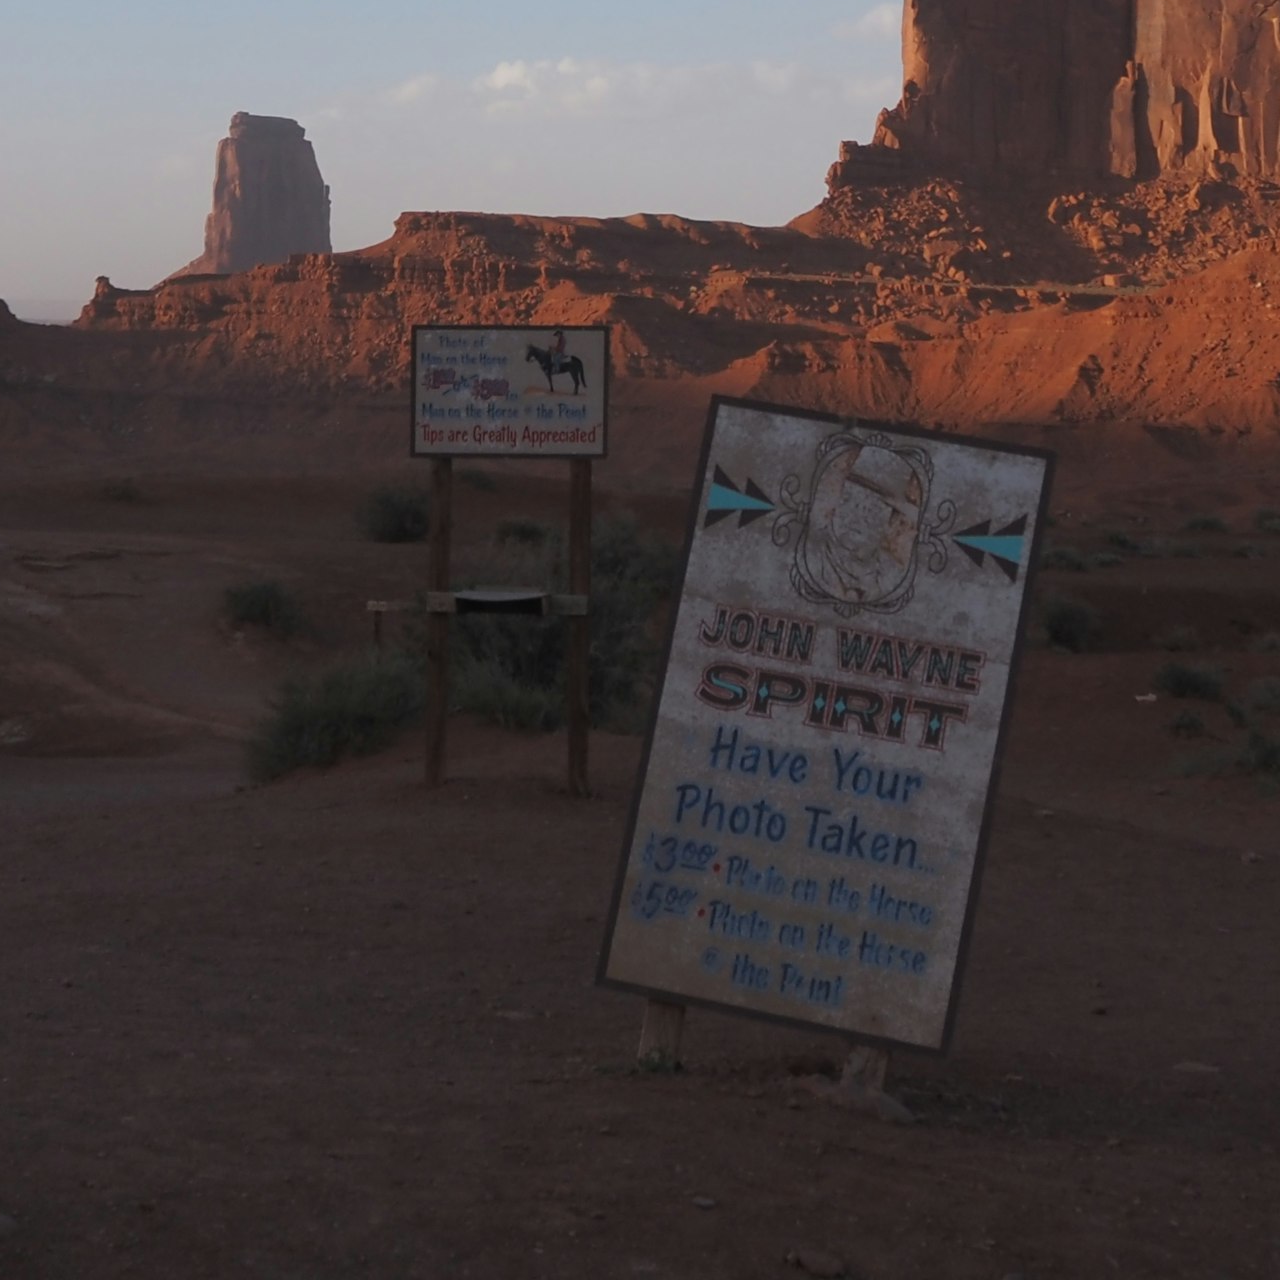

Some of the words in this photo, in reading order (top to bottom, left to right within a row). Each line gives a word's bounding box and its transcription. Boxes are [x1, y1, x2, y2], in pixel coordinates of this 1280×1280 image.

[421, 402, 444, 418] Man
[448, 407, 461, 418] on
[465, 403, 482, 418] the
[487, 402, 519, 420] Horse
[536, 403, 553, 418] the
[447, 429, 468, 443] are
[473, 423, 517, 448] Greatly
[699, 603, 816, 665] JOHN
[836, 626, 987, 695] WAYNE
[694, 660, 969, 752] SPIRIT
[709, 726, 808, 784] Have
[833, 748, 923, 803] Your
[676, 784, 786, 842] Photo
[726, 855, 785, 896] Photo
[791, 878, 818, 902] on
[828, 877, 861, 912] the
[870, 883, 933, 925] Horse
[709, 900, 770, 936] Photo
[778, 923, 804, 947] on
[816, 923, 850, 957] the
[859, 930, 927, 969] Horse
[731, 953, 769, 989] the
